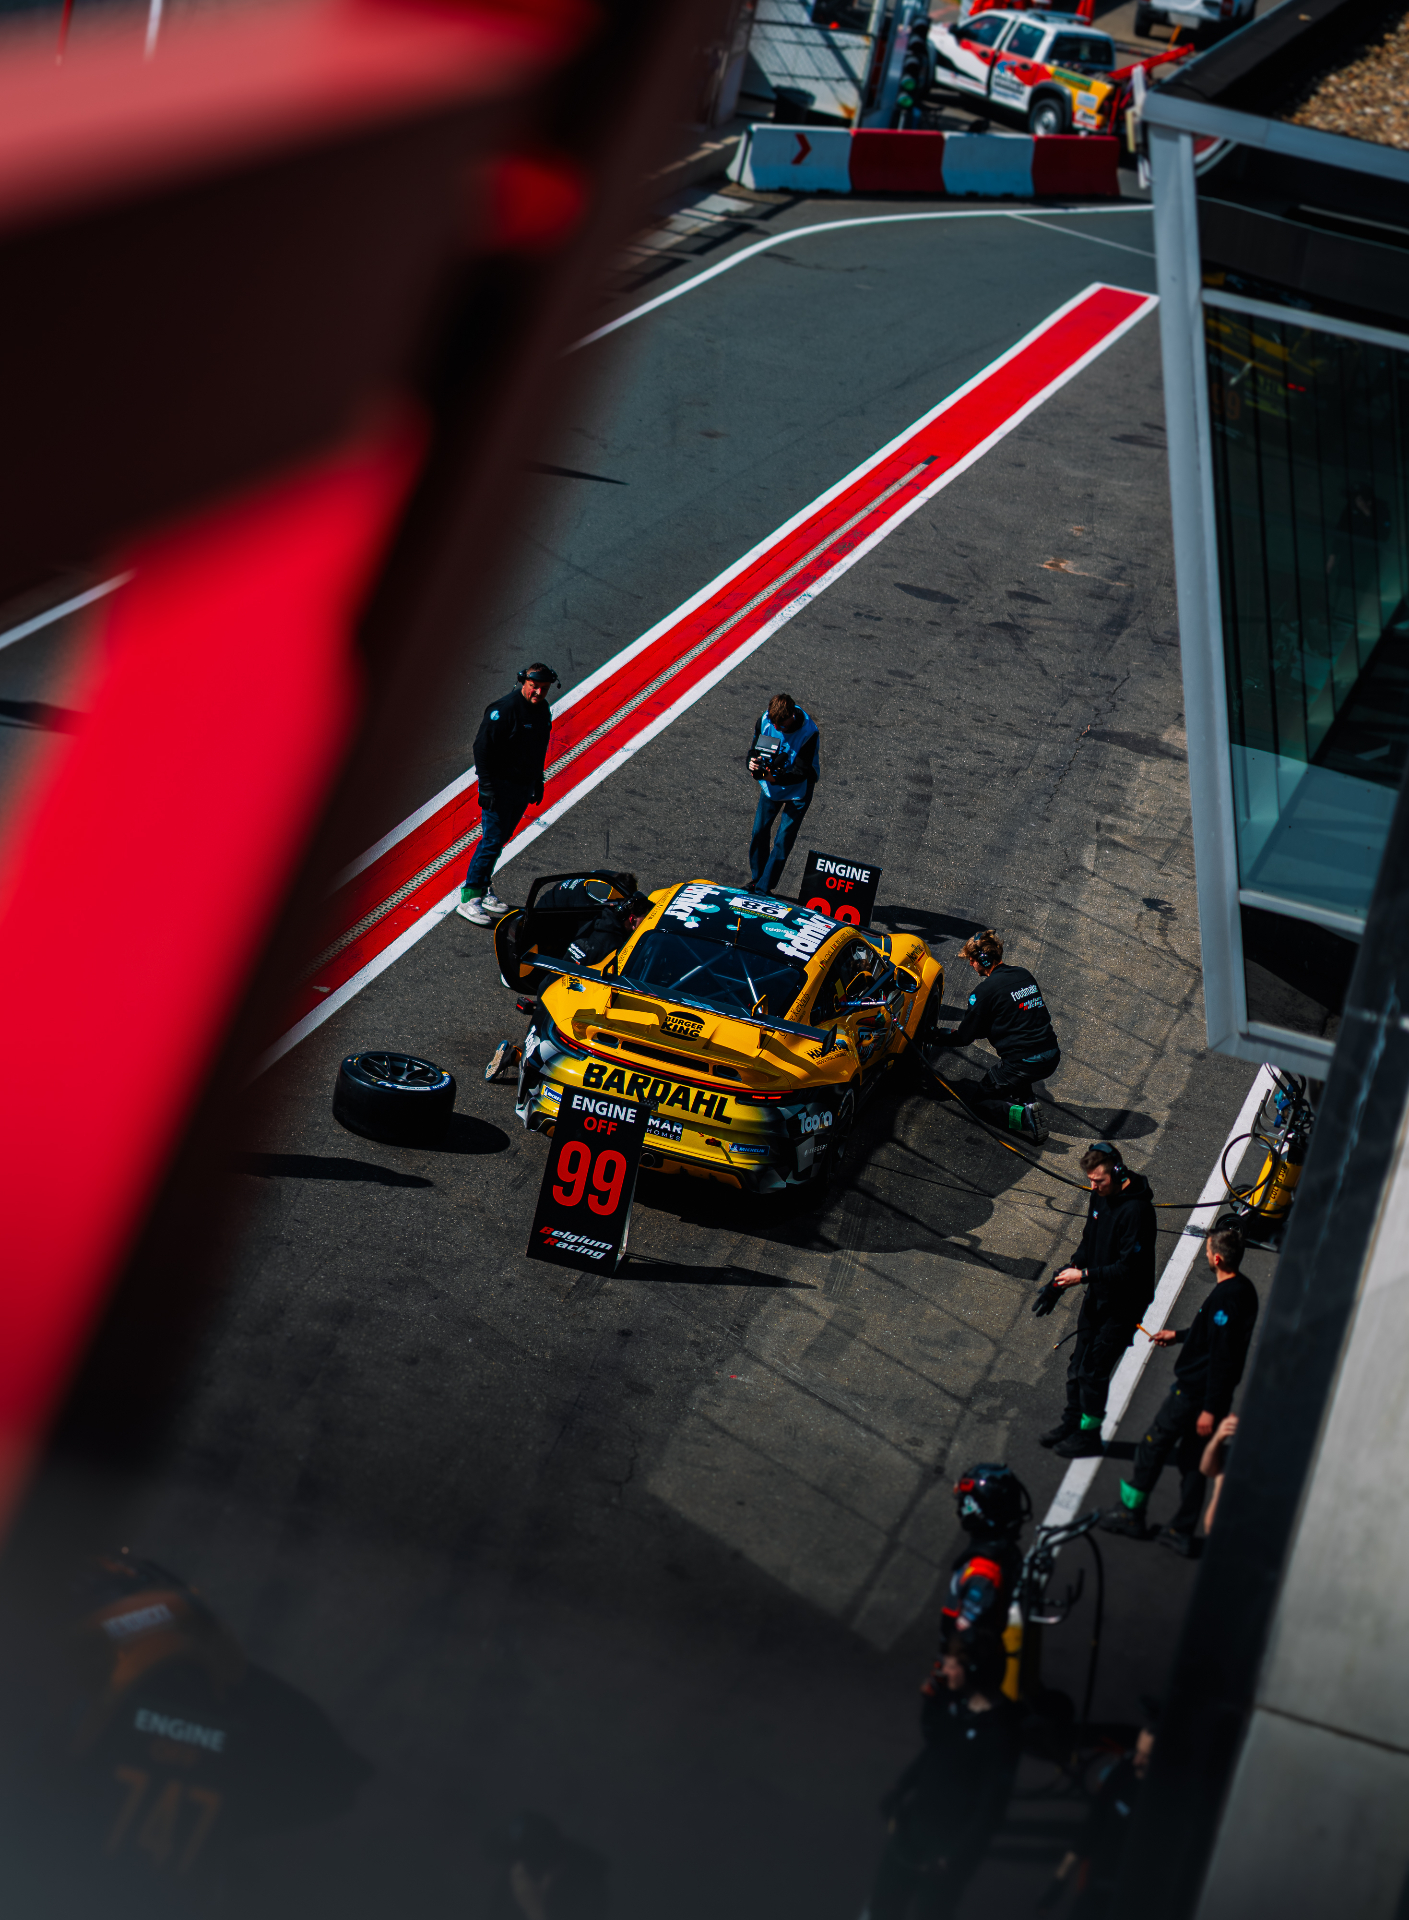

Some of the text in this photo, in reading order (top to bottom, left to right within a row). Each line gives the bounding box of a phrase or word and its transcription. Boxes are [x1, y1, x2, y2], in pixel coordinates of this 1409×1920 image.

[816, 858, 871, 883] ENGINE
[825, 876, 855, 893] OFF
[742, 899, 780, 915] 86
[661, 1021, 701, 1038] KING
[665, 1016, 704, 1031] BURGER
[582, 1062, 733, 1125] BARDAHL
[571, 1094, 638, 1124] ENGINE
[583, 1116, 618, 1136] OFF
[646, 1127, 682, 1142] HOMES
[552, 1140, 627, 1216] 99
[539, 1226, 613, 1251] Belgium
[543, 1237, 607, 1260] Racing
[134, 1708, 227, 1752] ENGINE
